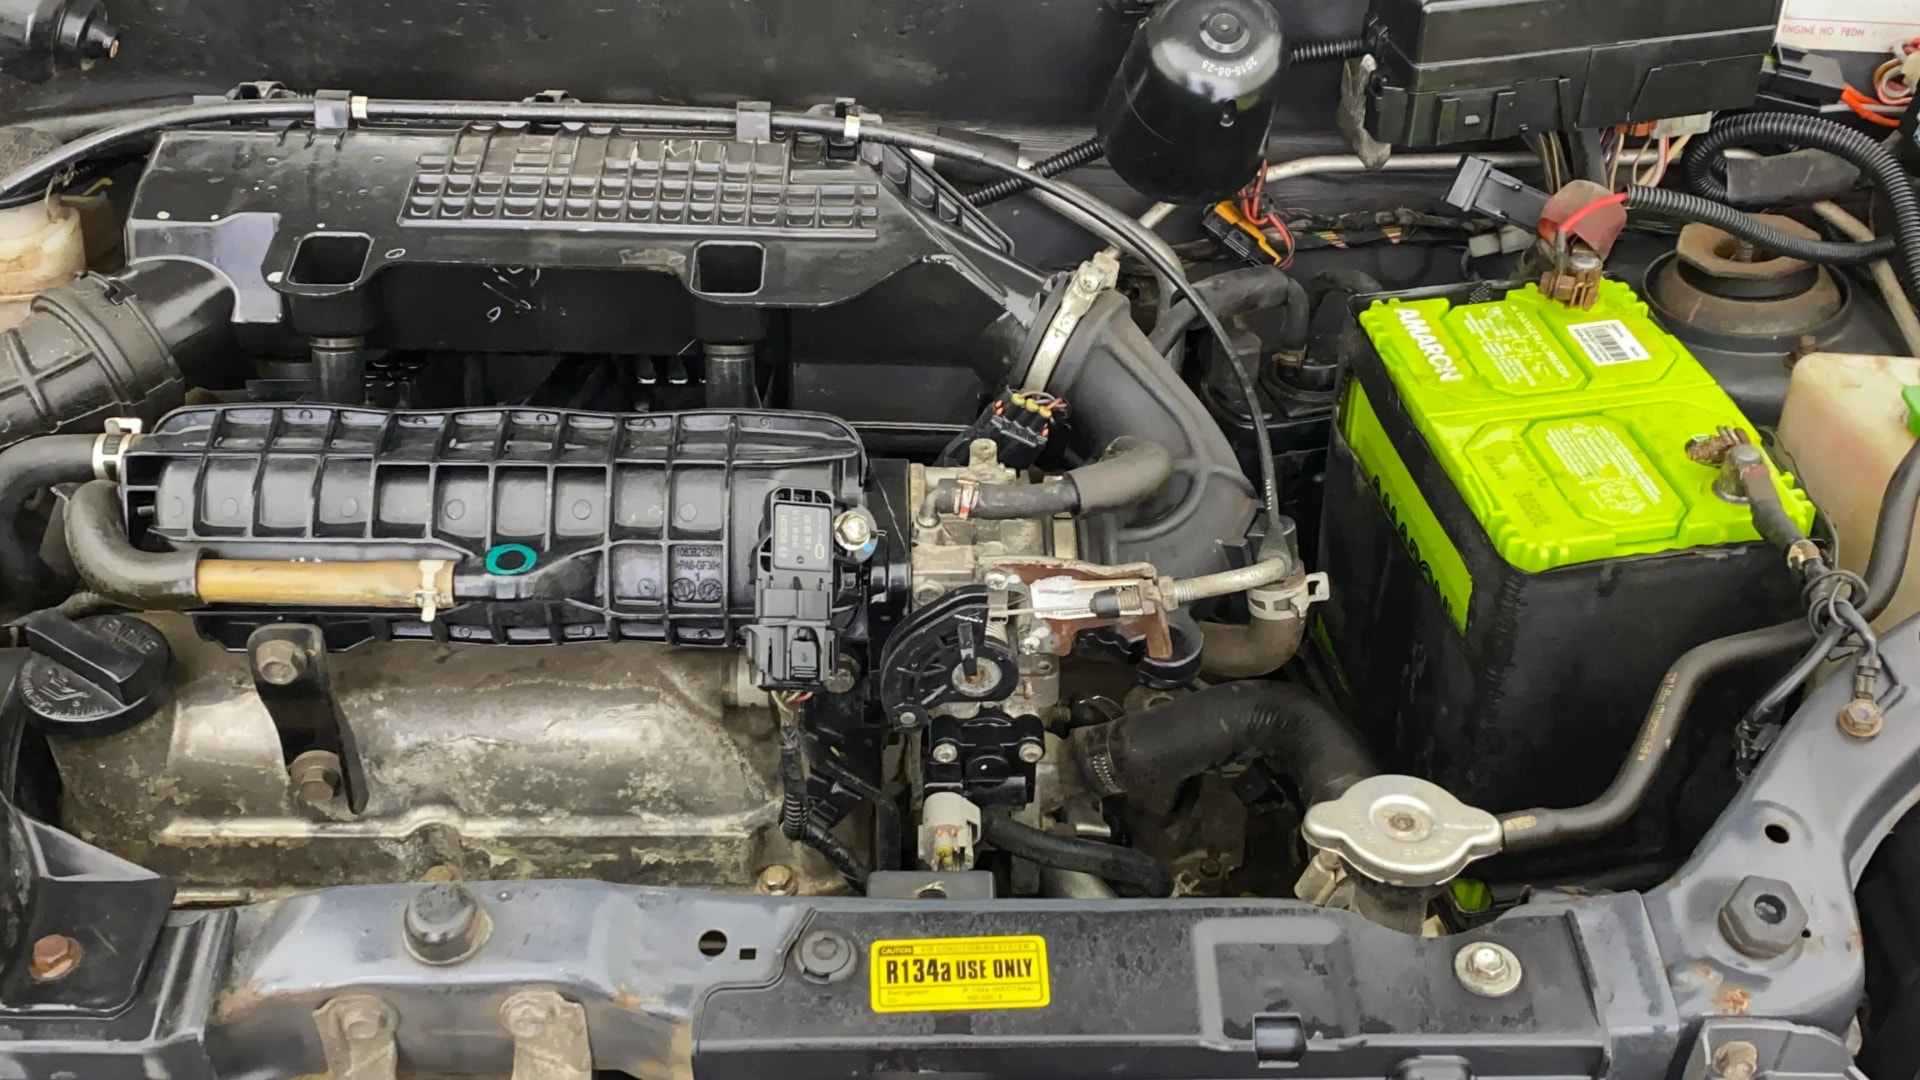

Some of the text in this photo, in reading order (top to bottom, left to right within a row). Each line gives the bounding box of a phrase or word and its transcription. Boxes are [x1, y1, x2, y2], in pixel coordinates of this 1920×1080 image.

[1781, 24, 1815, 35] ENGINE
[1819, 26, 1834, 36] NO
[1200, 56, 1258, 78] 2015-08-25
[1393, 307, 1464, 382] AMARON
[880, 946, 912, 955] CAUTION
[886, 958, 1032, 984] R134a USE ONLY
